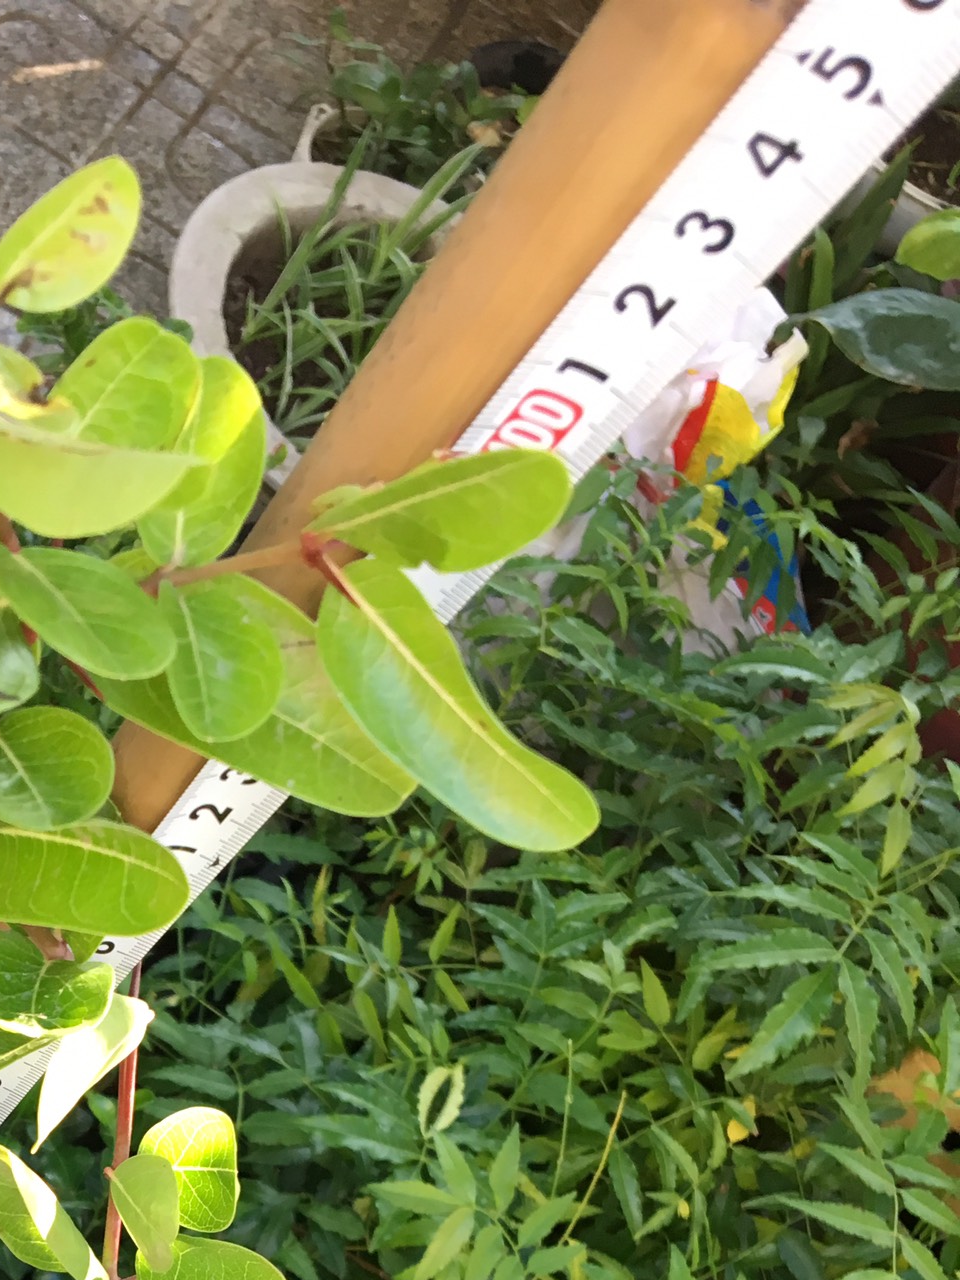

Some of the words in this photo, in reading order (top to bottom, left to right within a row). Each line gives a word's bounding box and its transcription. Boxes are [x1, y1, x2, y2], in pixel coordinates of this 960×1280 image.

[487, 393, 578, 450] 00
[557, 358, 609, 383] 1
[614, 284, 676, 328] 2
[675, 211, 735, 253] 3
[747, 132, 804, 179] 4
[811, 47, 873, 100] 5
[189, 804, 233, 825] 2
